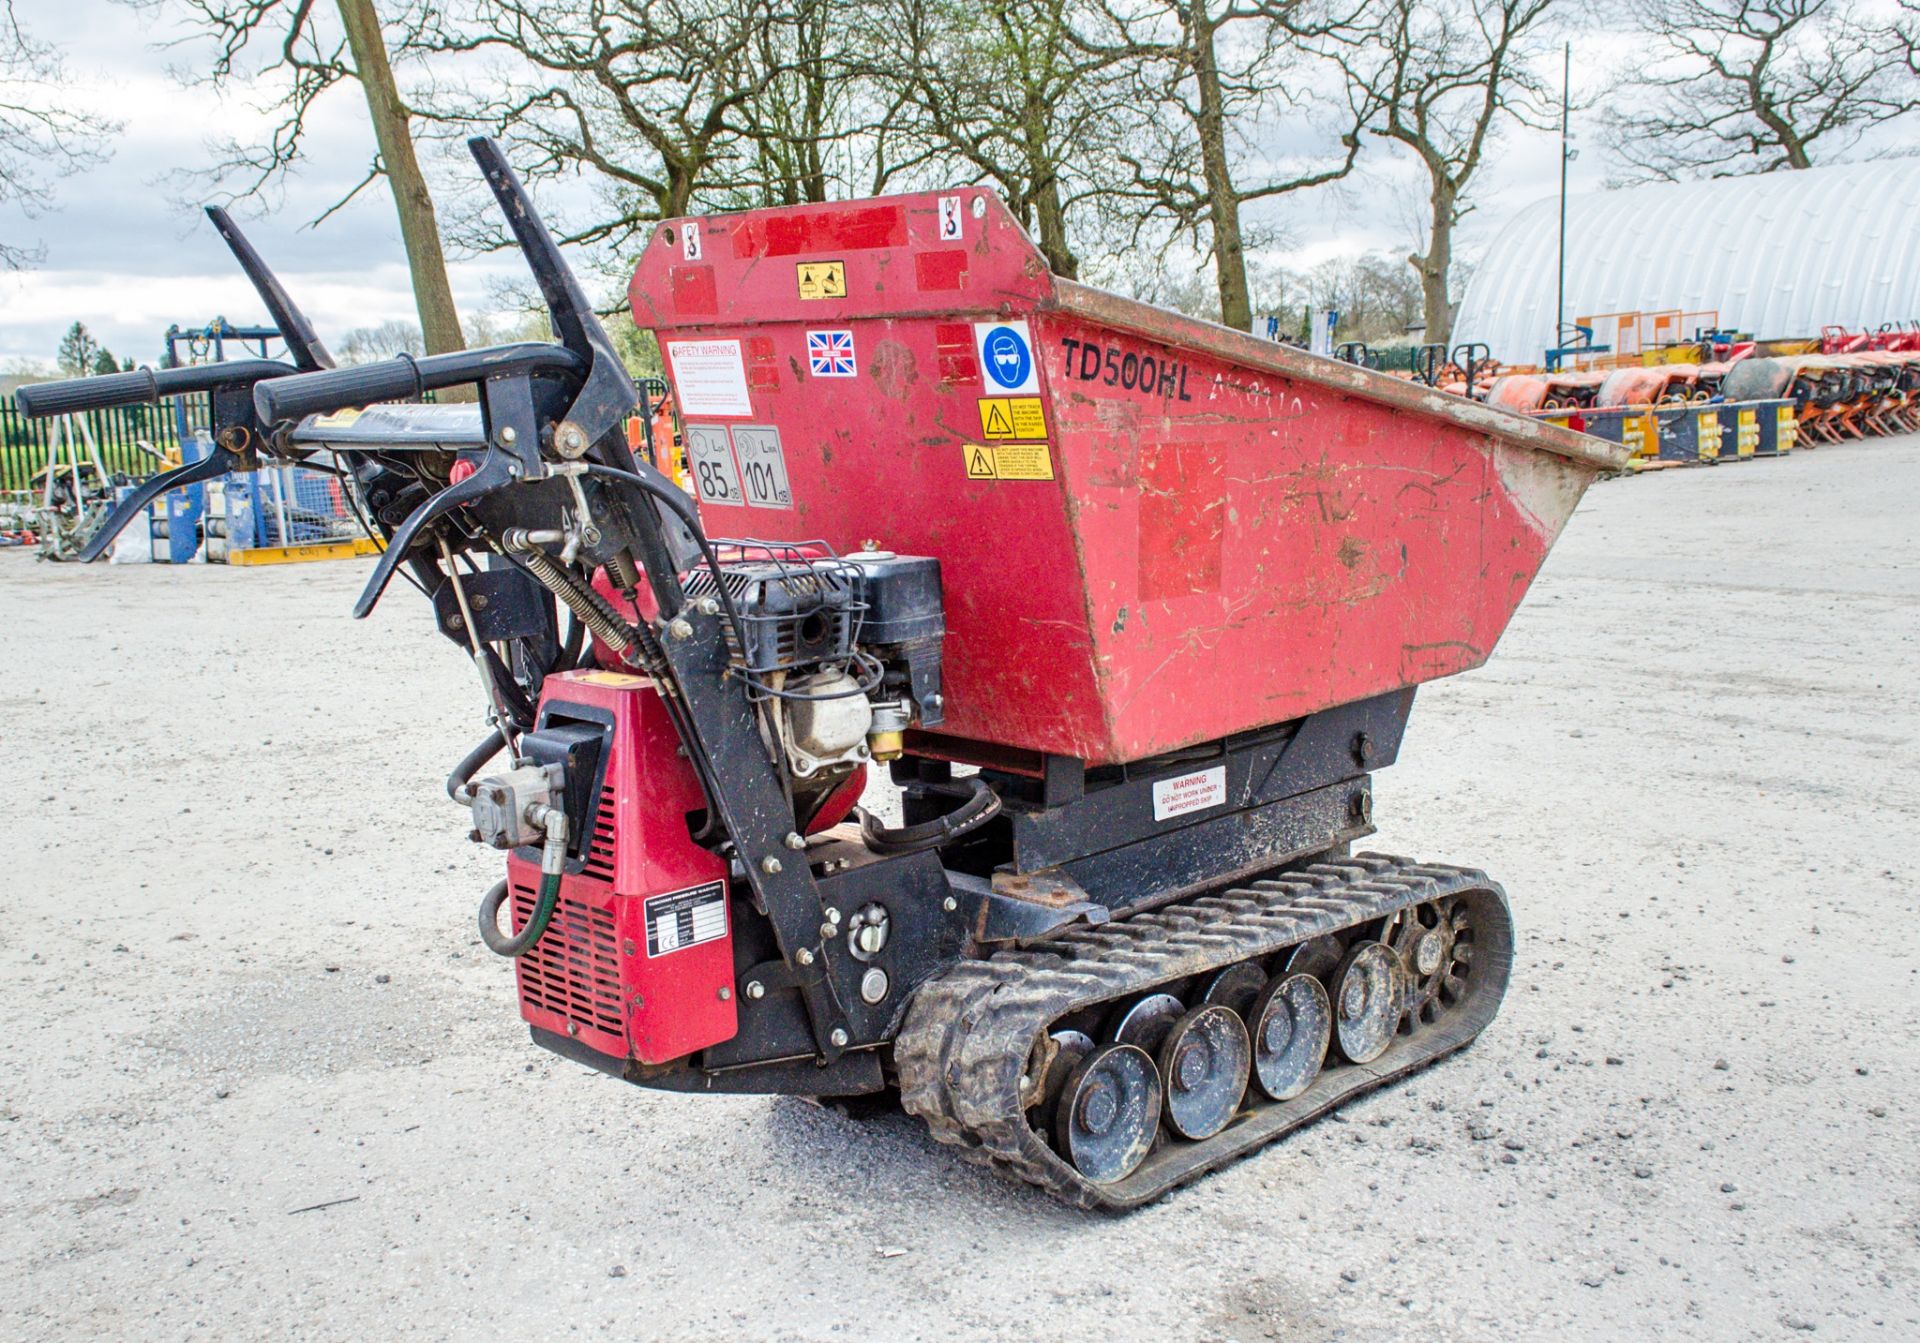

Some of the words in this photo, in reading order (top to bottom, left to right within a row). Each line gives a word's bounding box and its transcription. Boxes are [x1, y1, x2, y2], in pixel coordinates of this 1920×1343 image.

[673, 345, 700, 357] SAFETY
[700, 344, 736, 356] WARNING
[1062, 338, 1191, 401] TD500HL
[699, 461, 728, 498] 85
[730, 488, 739, 499] dB
[746, 462, 778, 500] 101
[779, 490, 788, 502] dB
[1173, 774, 1207, 790] WARNING
[1162, 796, 1170, 804] DO
[1171, 793, 1182, 802] NOT
[1183, 789, 1198, 799] WORK
[1200, 784, 1217, 795] UNDER
[1168, 798, 1199, 813] UNPROPPED
[1200, 795, 1212, 804] SKIP
